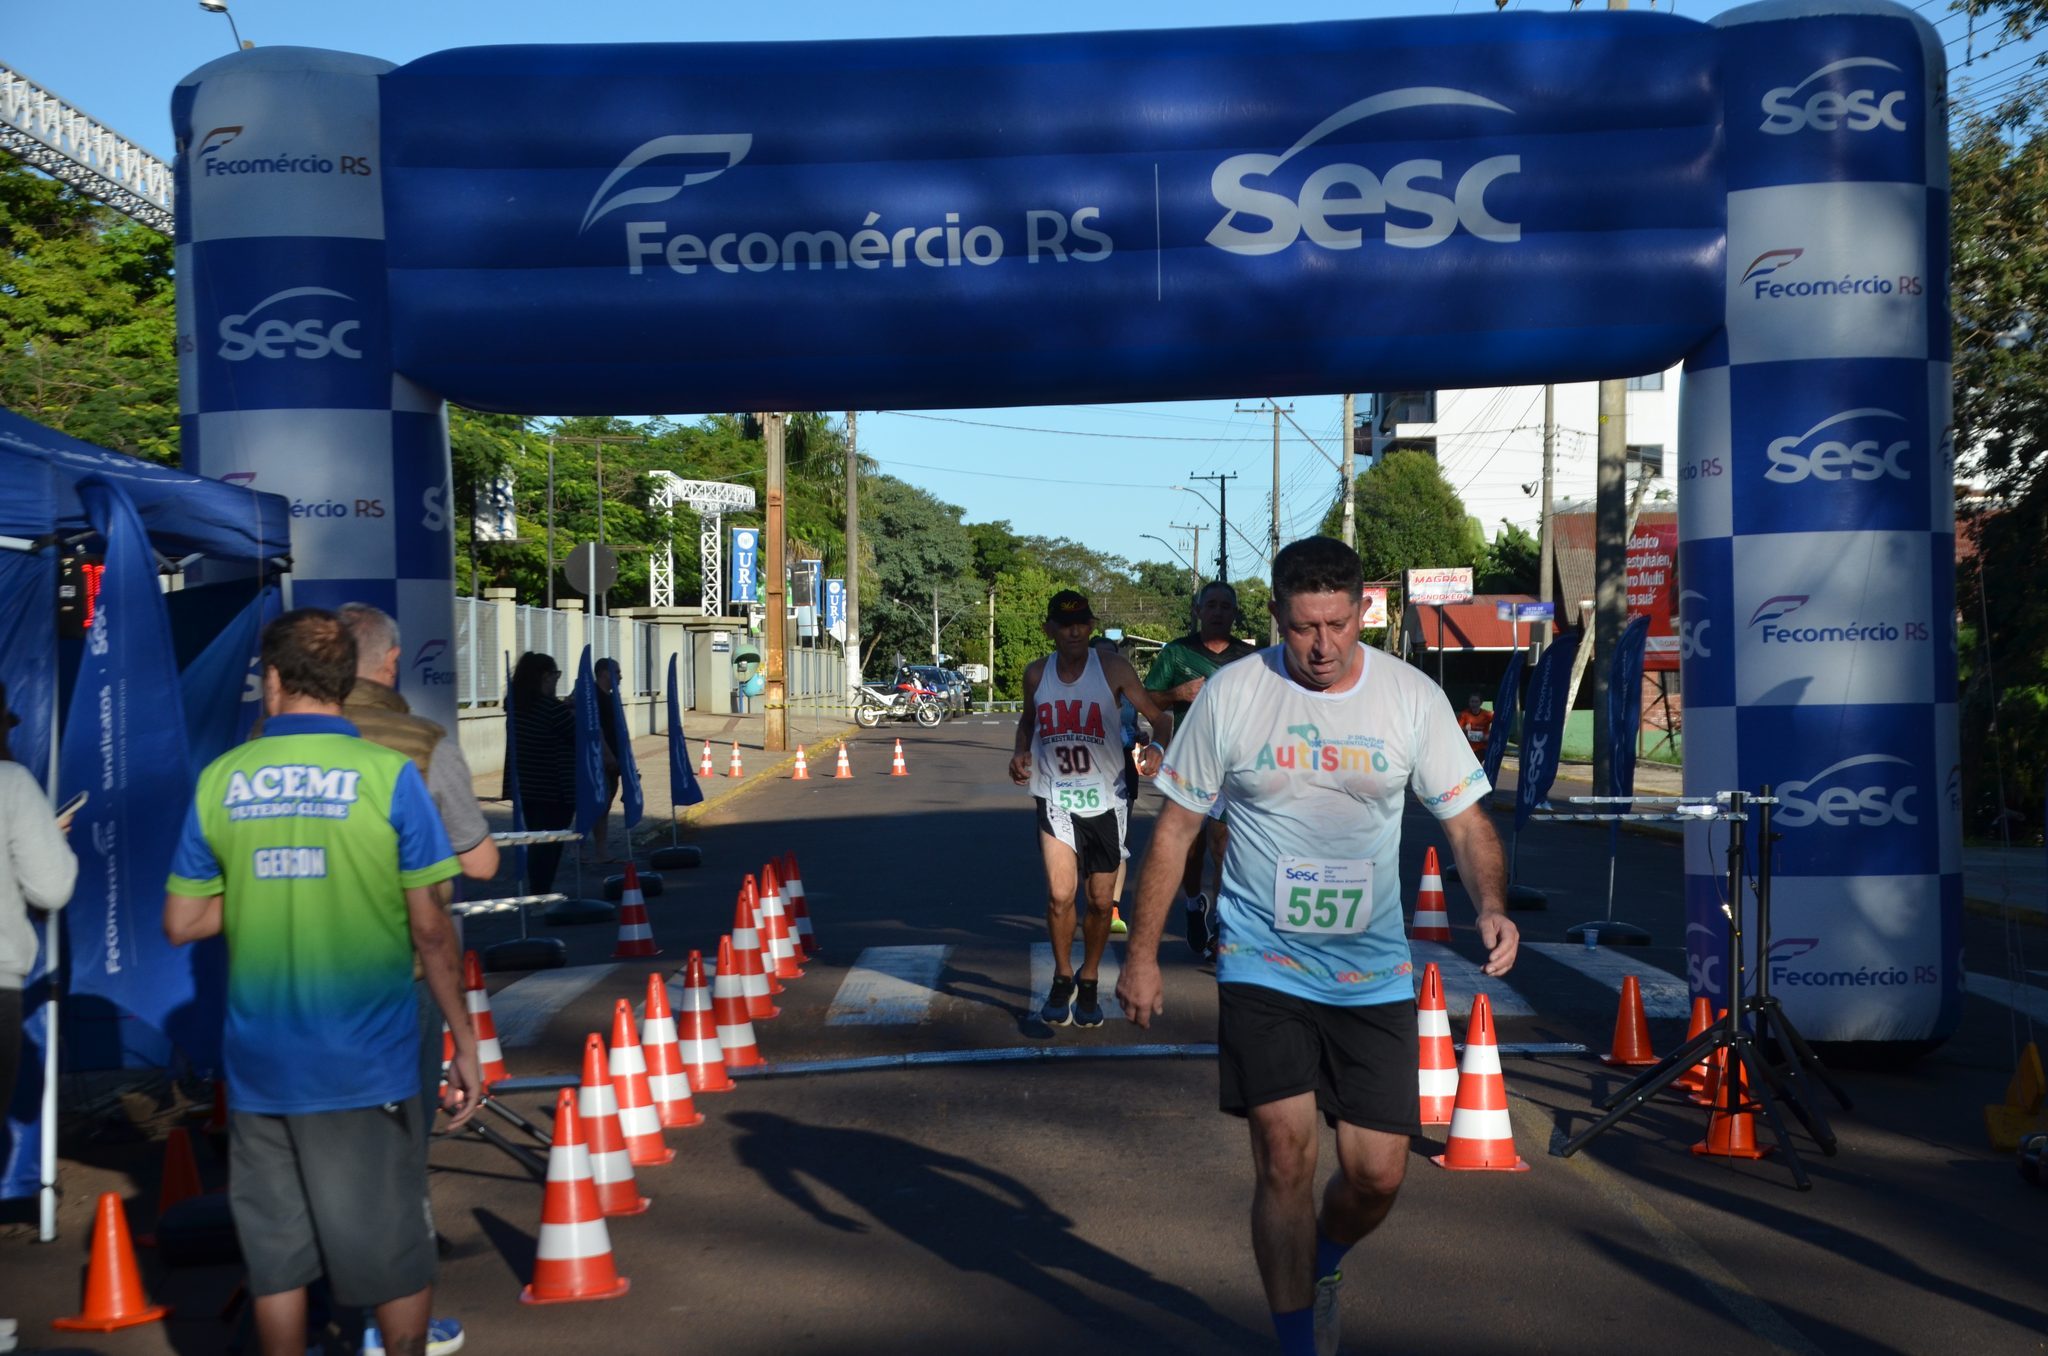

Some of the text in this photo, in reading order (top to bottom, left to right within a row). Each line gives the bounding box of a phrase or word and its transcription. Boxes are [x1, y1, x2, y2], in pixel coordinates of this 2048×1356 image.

[205, 152, 372, 177] Fecomércio RS
[626, 206, 1114, 276] Fecomércio RS
[1754, 274, 1923, 300] Fecomércio RS
[1701, 457, 1724, 478] RS
[289, 499, 385, 518] ércio RS
[1626, 552, 1672, 570] estphalen,
[738, 552, 753, 600] URI
[1641, 570, 1665, 587] Multi
[1682, 619, 1711, 660] sc
[1762, 622, 1929, 644] Fecomércio RS
[1038, 699, 1106, 739] BMA
[1055, 745, 1091, 775] 30
[1254, 739, 1390, 774] Autismo
[224, 763, 362, 807] ACEMI
[1059, 787, 1100, 811] 536
[1287, 886, 1364, 929] 557
[1688, 953, 1720, 994] sc
[1771, 964, 1938, 988] Fecomércio RS
